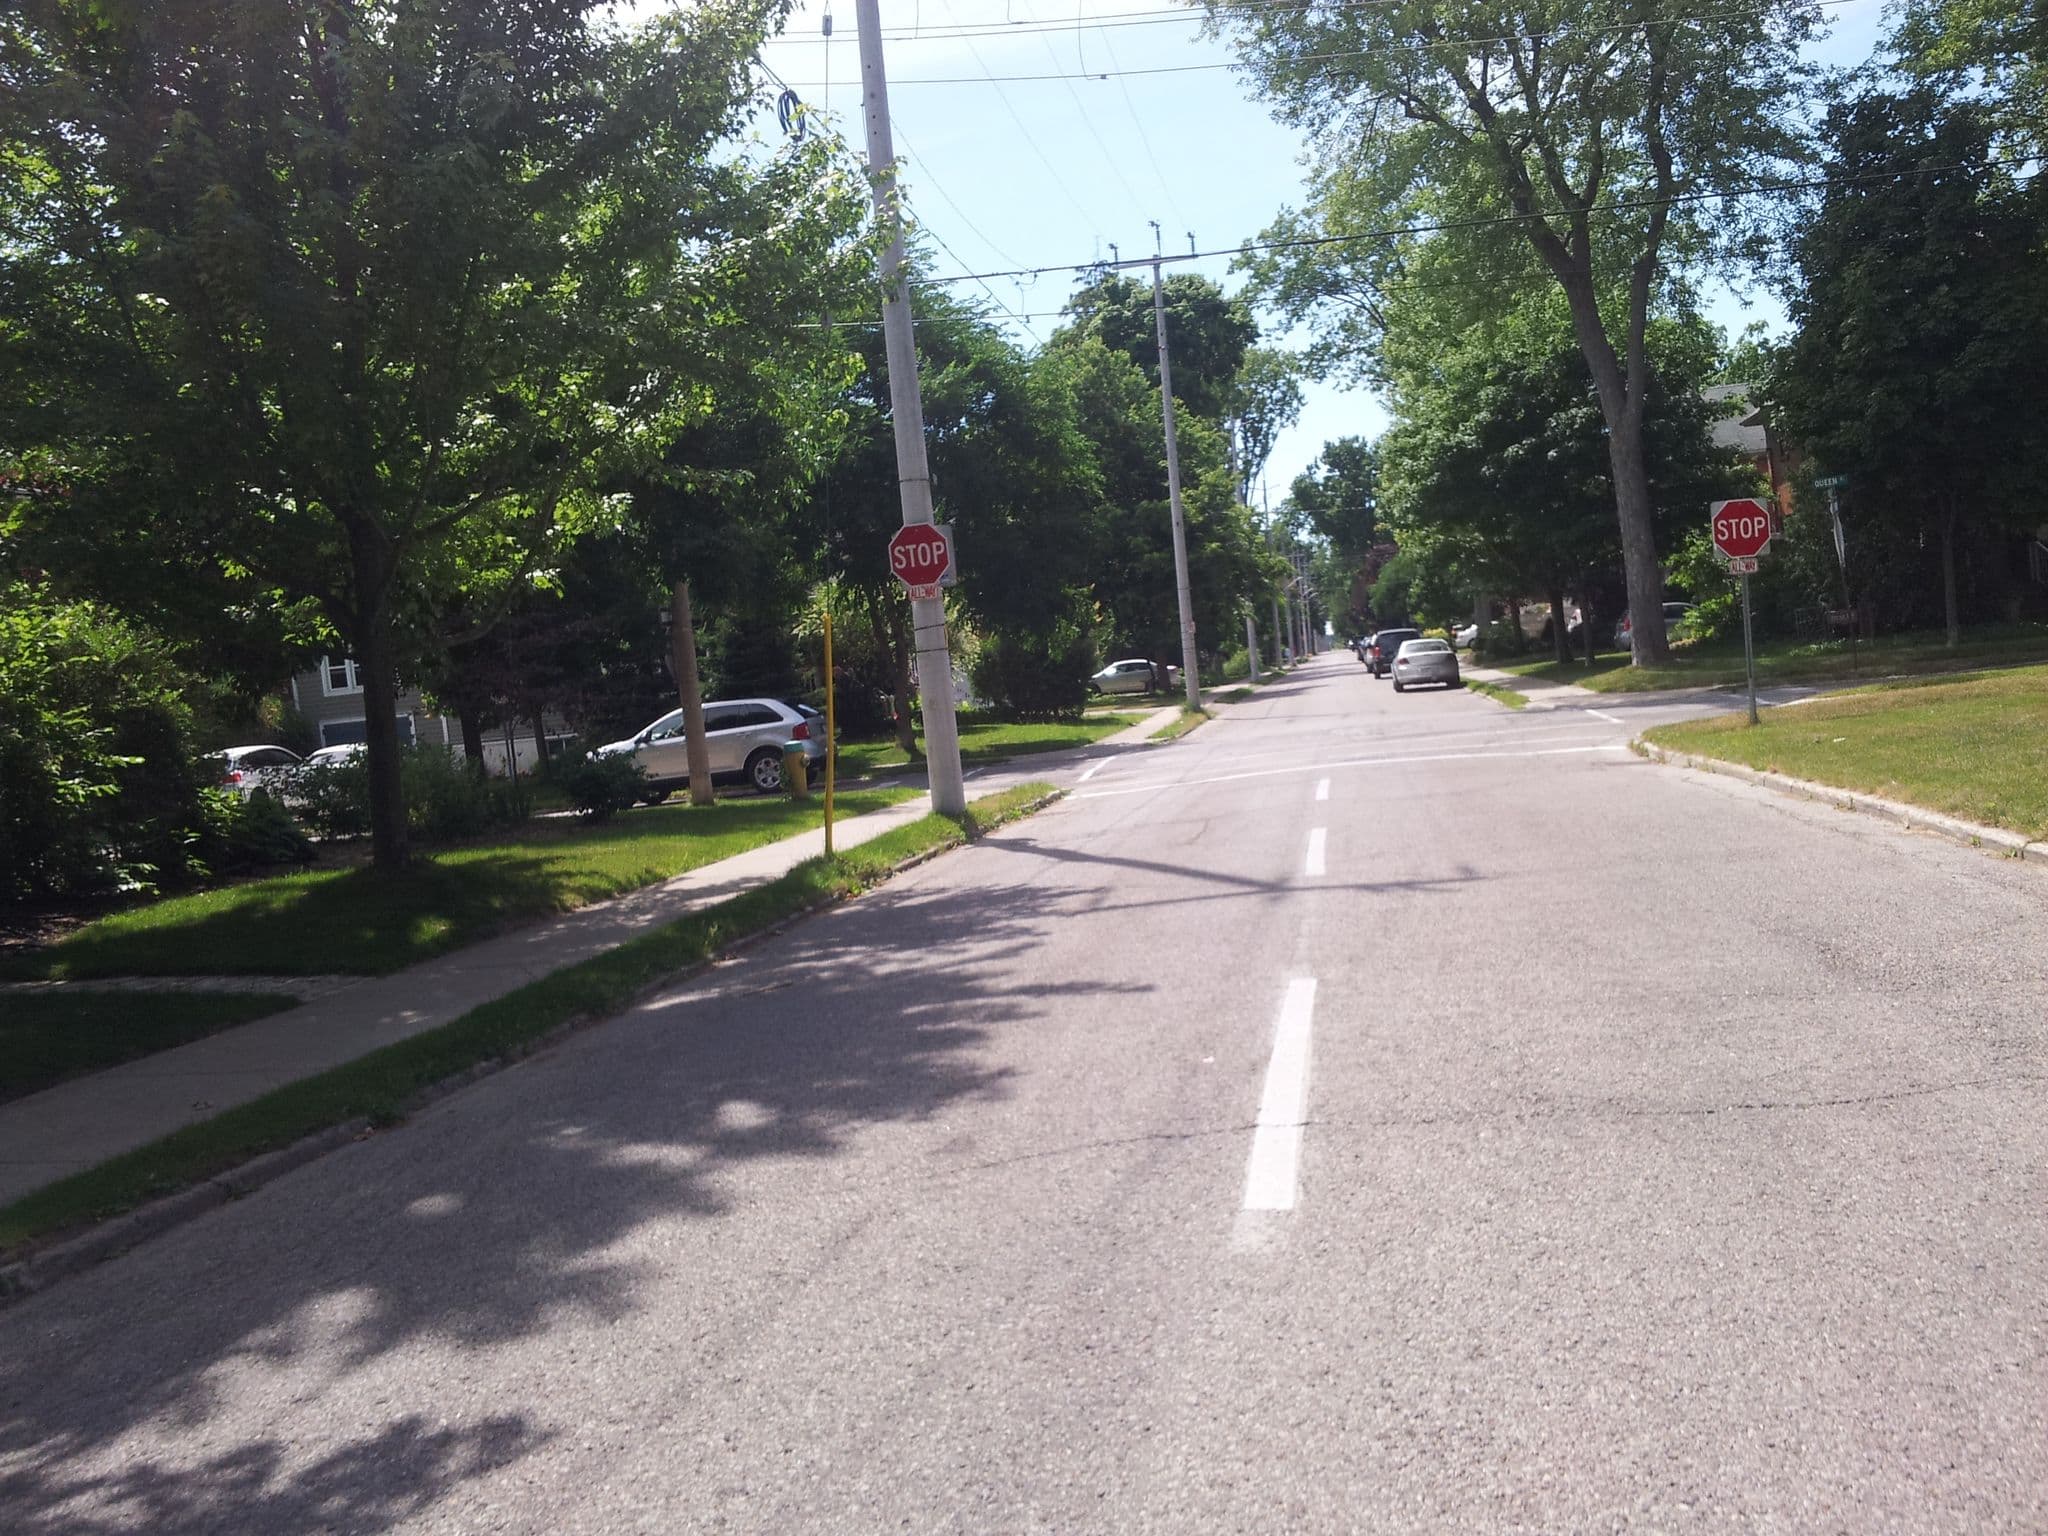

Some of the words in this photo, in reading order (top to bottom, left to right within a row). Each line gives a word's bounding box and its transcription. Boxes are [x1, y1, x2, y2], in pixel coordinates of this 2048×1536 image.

[1814, 477, 1838, 488] QUEEN
[1717, 516, 1766, 541] STOP
[893, 541, 945, 569] STOP
